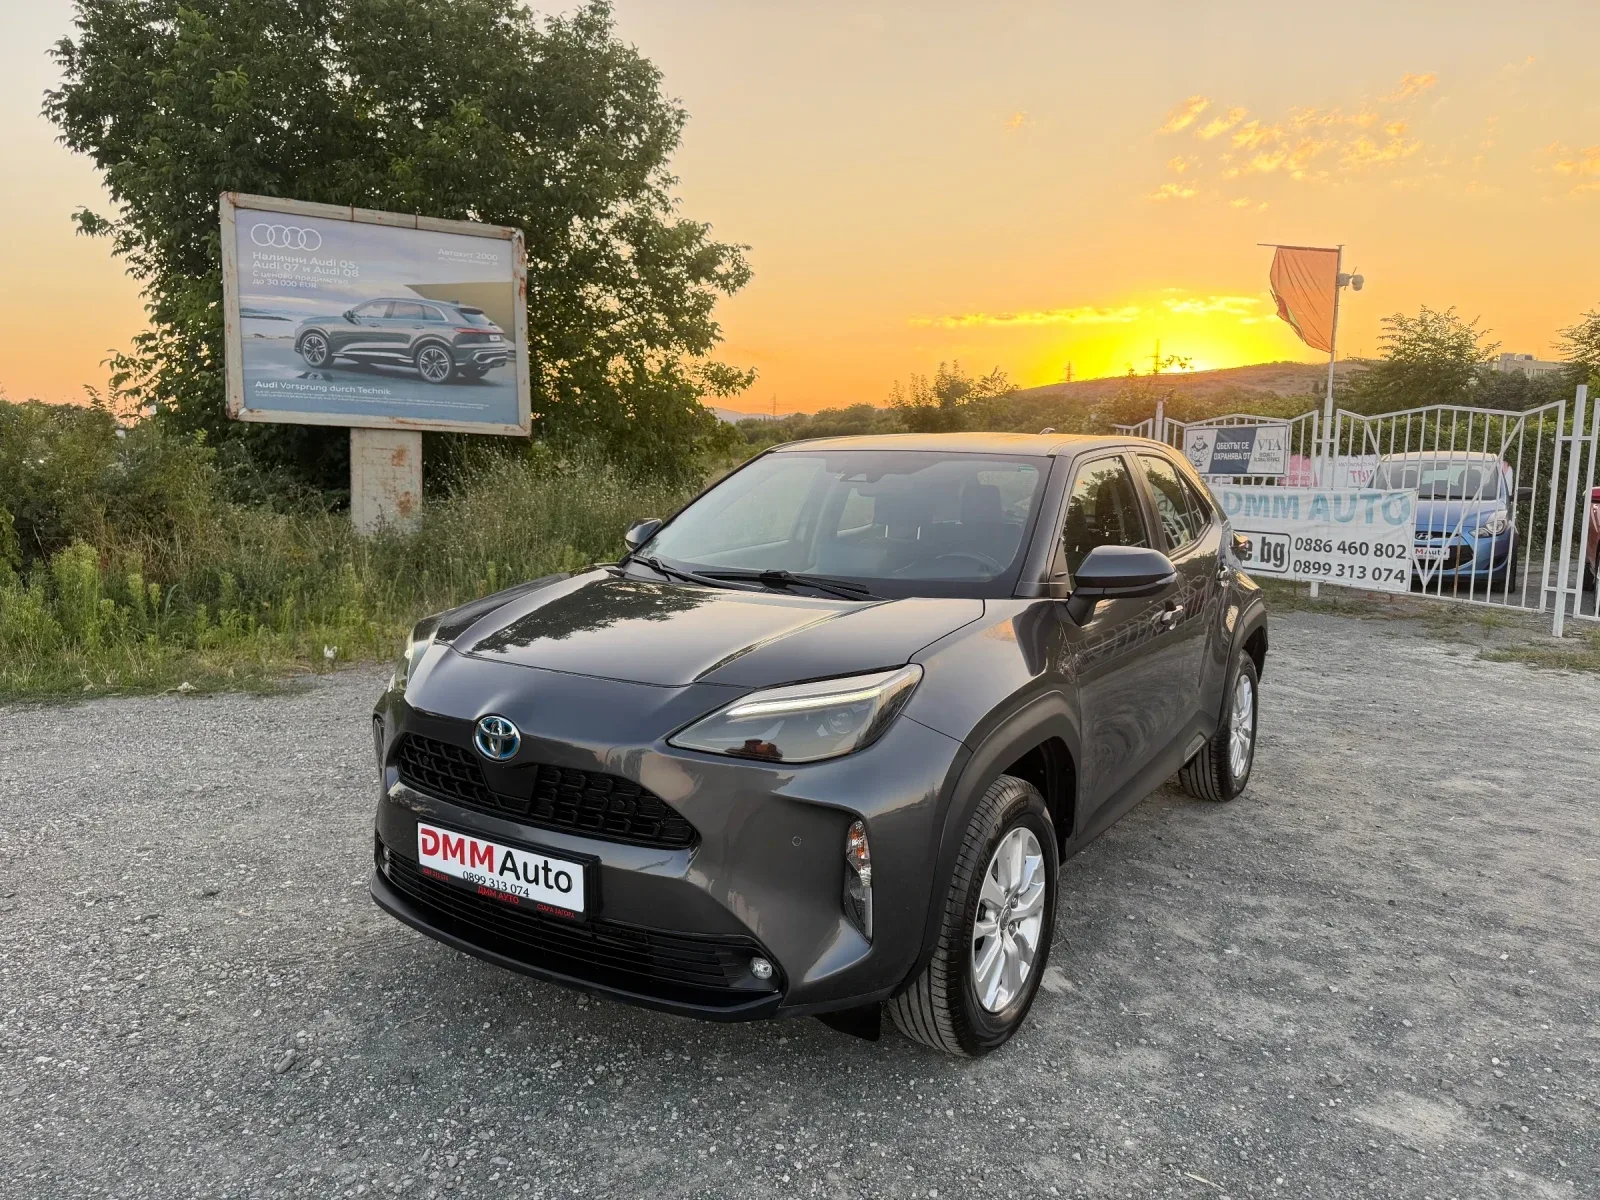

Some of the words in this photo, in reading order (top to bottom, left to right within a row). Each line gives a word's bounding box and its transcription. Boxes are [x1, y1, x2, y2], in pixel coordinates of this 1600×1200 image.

[252, 251, 307, 265] Налични
[310, 256, 337, 267] Audi
[475, 252, 498, 261] 2000
[252, 260, 280, 270] Audi
[283, 262, 299, 272] Q7
[313, 265, 340, 276] Audi
[343, 268, 360, 279] Q8
[266, 278, 279, 286] 30
[299, 281, 317, 289] EUR
[255, 380, 278, 389] Audi
[280, 382, 328, 393] Vorsprung
[329, 384, 356, 393] durch
[357, 386, 392, 396] Technik
[1216, 441, 1241, 450] ОБЕКТЪТ
[1241, 441, 1250, 450] СЕ
[1213, 452, 1243, 460] ОХРАНЯВА
[1242, 452, 1251, 460] ОТ
[1223, 491, 1300, 521] DMM
[1307, 492, 1411, 526] AUTO
[1294, 537, 1333, 554] 0886
[1337, 540, 1370, 556] 460
[1373, 543, 1407, 560] 802
[1293, 559, 1332, 575] 0899
[1335, 563, 1367, 580] 313
[1371, 566, 1406, 584] 074
[420, 827, 495, 874] DMM
[498, 850, 573, 894] Auto
[462, 870, 487, 886] 0899
[488, 877, 508, 892] 313
[510, 884, 530, 898] 074
[477, 885, 497, 898] ДММ
[498, 891, 520, 905] АУТО
